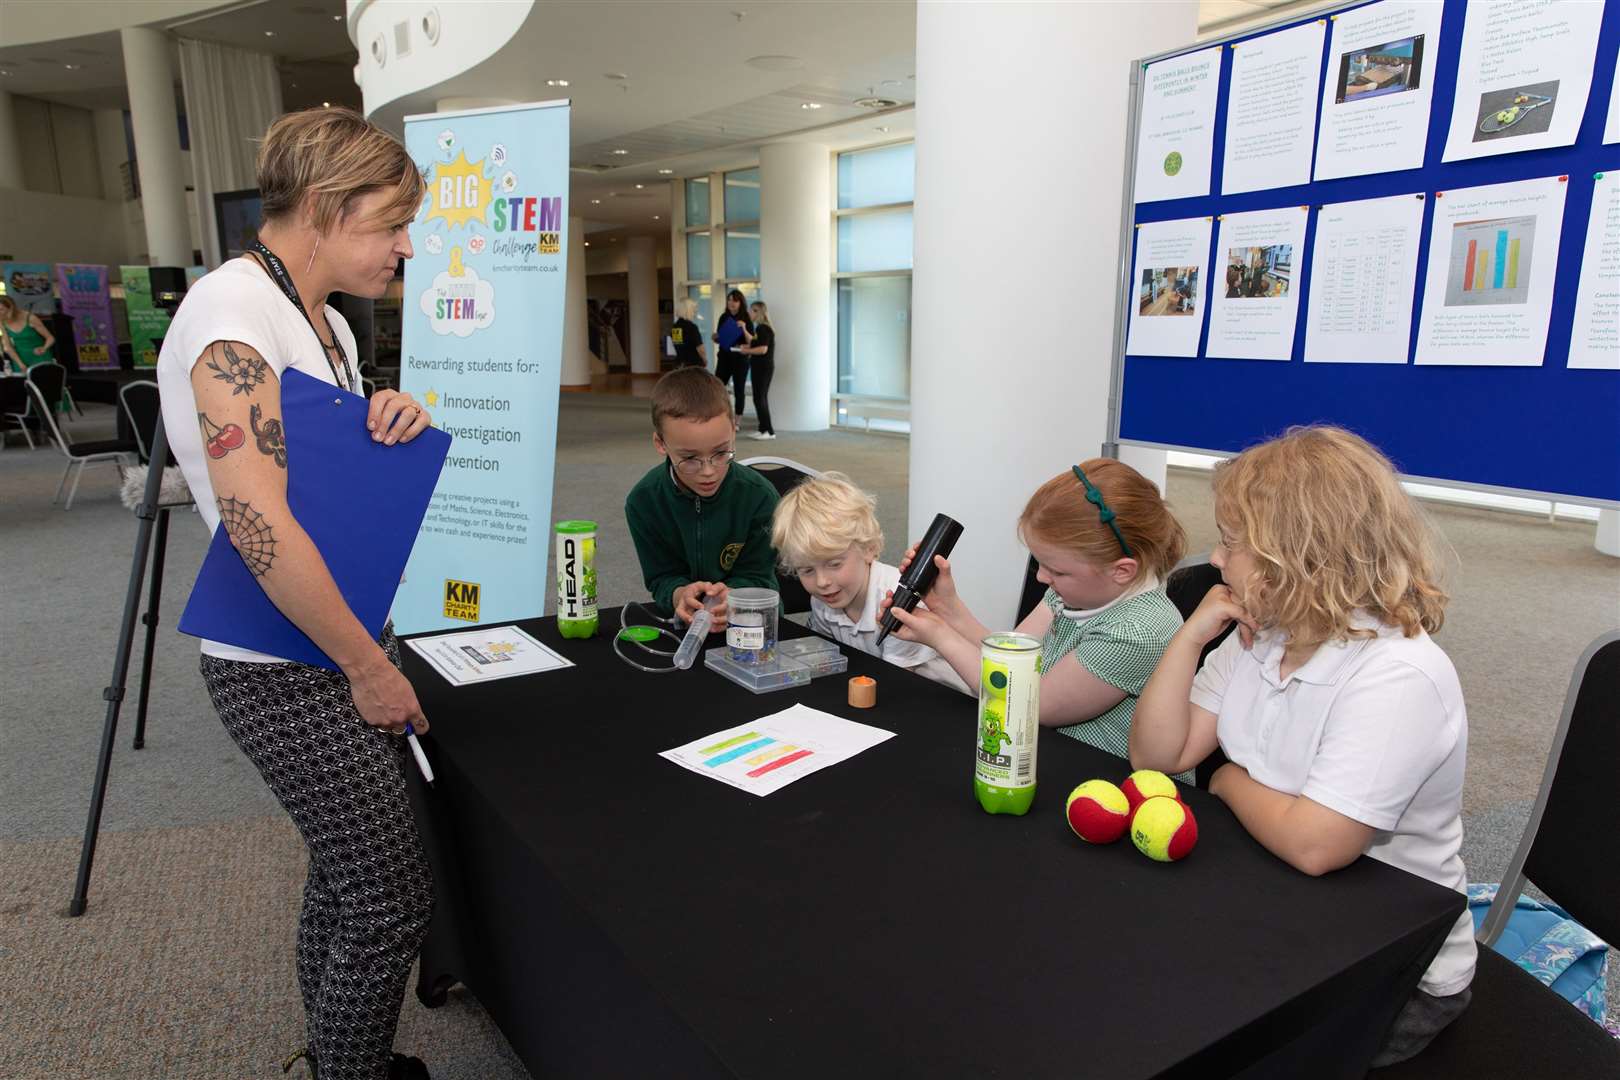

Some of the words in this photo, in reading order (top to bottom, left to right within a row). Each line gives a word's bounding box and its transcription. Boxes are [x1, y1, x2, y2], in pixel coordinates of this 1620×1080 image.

[440, 174, 479, 209] BIG
[494, 197, 562, 232] STEM
[540, 233, 559, 245] KM
[270, 257, 284, 276] STAFF
[436, 298, 475, 320] STEM
[408, 356, 464, 375] Rewarding
[467, 358, 513, 372] students
[516, 358, 540, 374] for:
[443, 392, 511, 411] Innovation
[442, 422, 521, 445] Investigation
[444, 455, 500, 471] nvention
[473, 496, 498, 505] projects
[445, 527, 459, 536] cash
[472, 530, 506, 543] experience
[505, 521, 515, 530] for
[565, 538, 578, 618] HEAD
[447, 582, 478, 605] KM
[446, 602, 477, 611] CHARITY
[446, 608, 477, 620] TEAM
